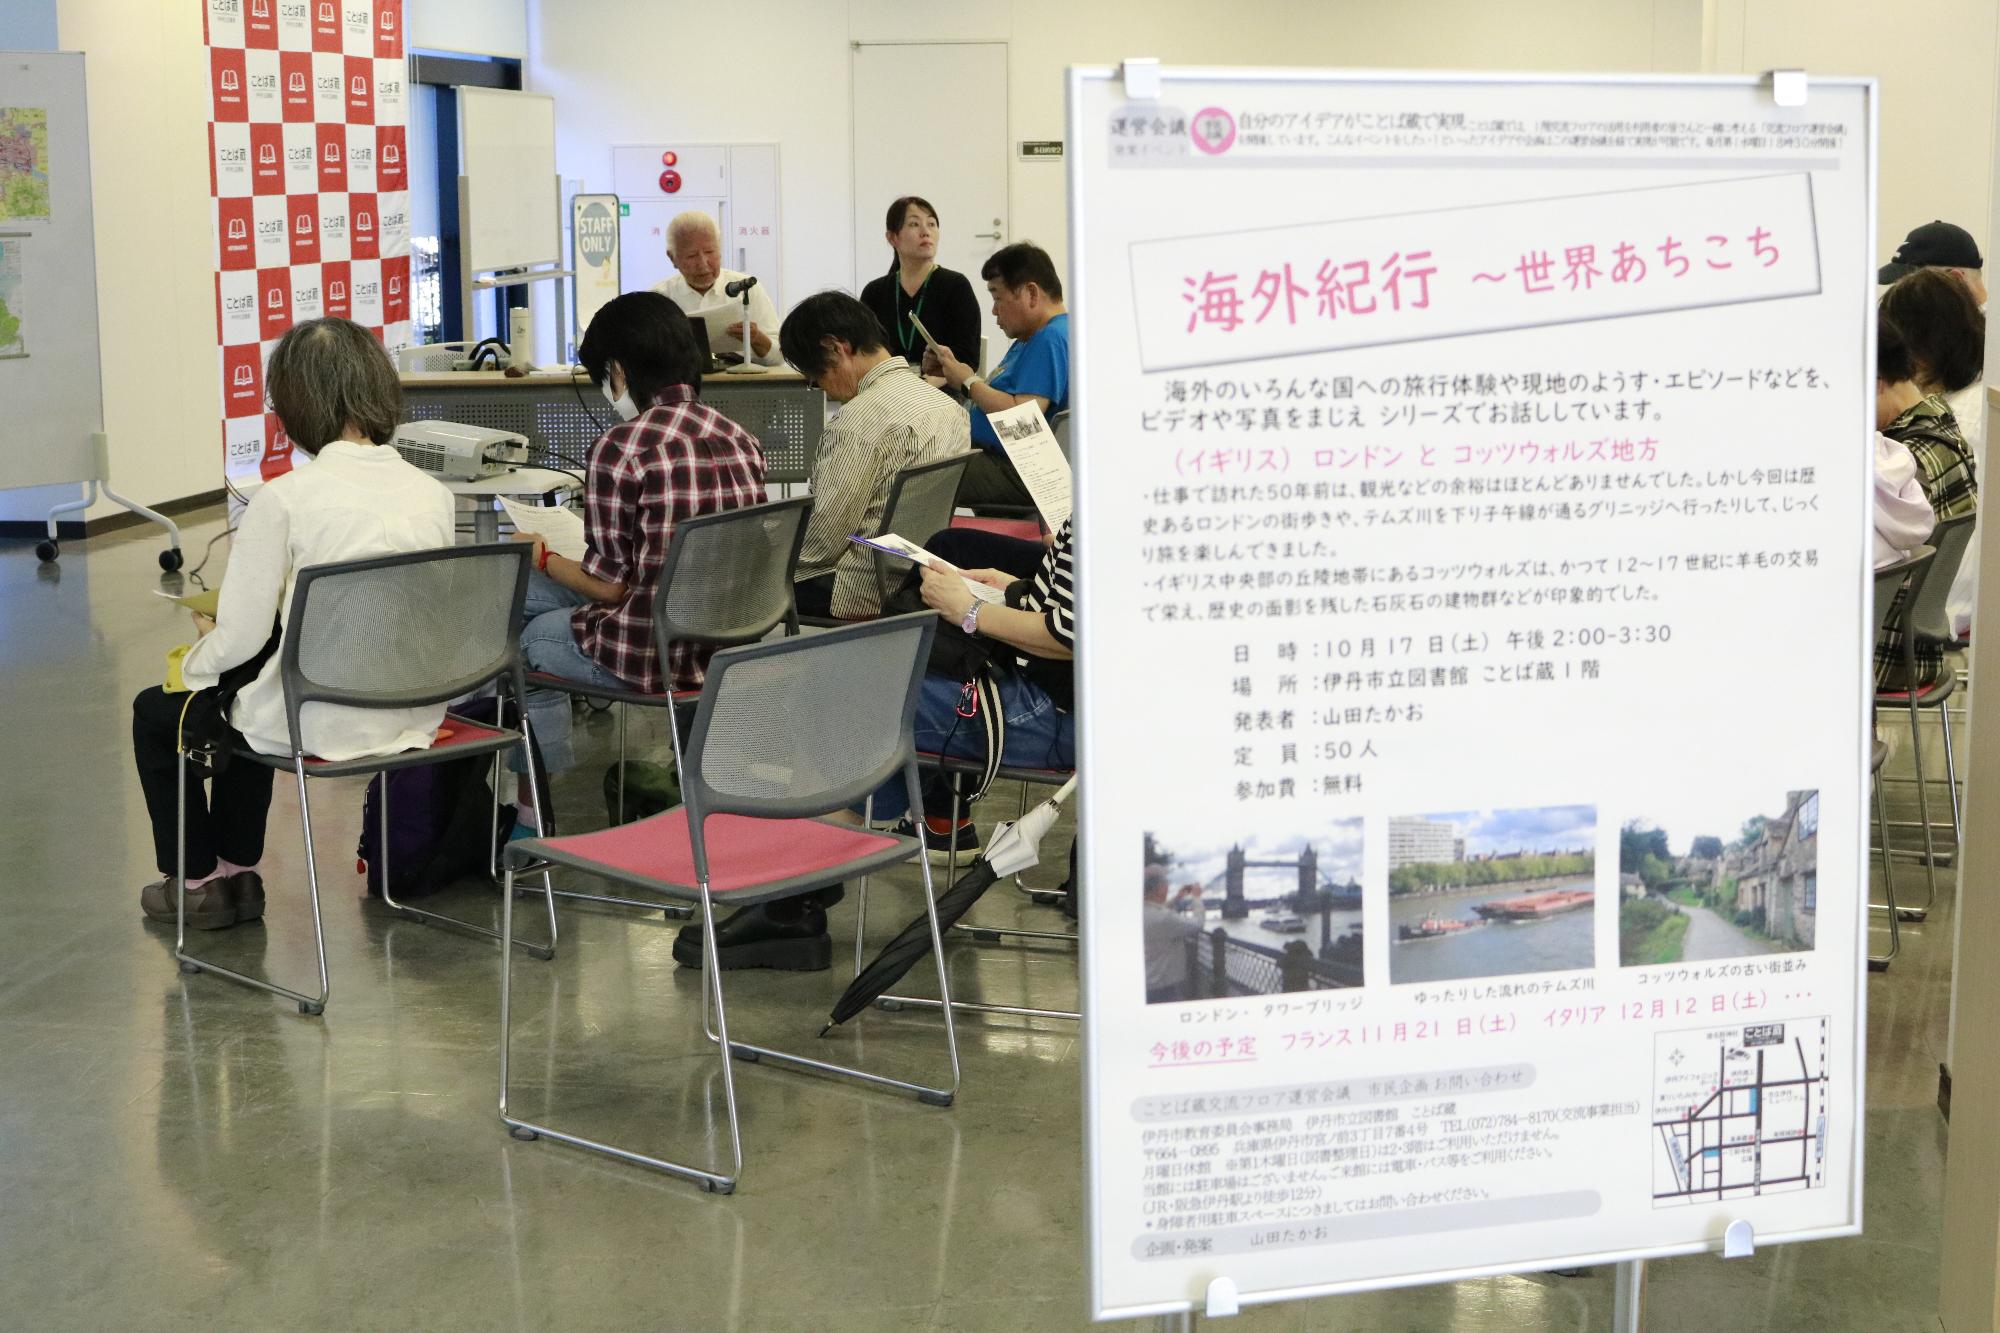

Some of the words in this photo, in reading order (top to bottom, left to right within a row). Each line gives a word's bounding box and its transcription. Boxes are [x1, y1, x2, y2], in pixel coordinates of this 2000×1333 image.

[580, 217, 614, 235] STAFF
[739, 226, 770, 236] 消火器
[582, 234, 612, 253] ONLY
[1182, 250, 1440, 333] 海外紀行
[1142, 406, 1365, 432] ビデオや写真をまじえ
[1380, 399, 1662, 426] シリーズでお話ししています。
[1315, 446, 1403, 470] ロンドン
[1419, 445, 1435, 466] と
[1454, 437, 1659, 464] コッツウォルズ地方
[1234, 709, 1295, 732] 発表者
[1234, 777, 1296, 799] 参加費
[1638, 959, 1807, 985] コッツウォルズの古い街並み
[1414, 977, 1594, 1005] ゆったりした流れのテムズ川
[1150, 1036, 1257, 1061] 今後の予定
[1434, 1070, 1524, 1092] お問い合わせ
[1250, 1226, 1328, 1246] 山田たかお
